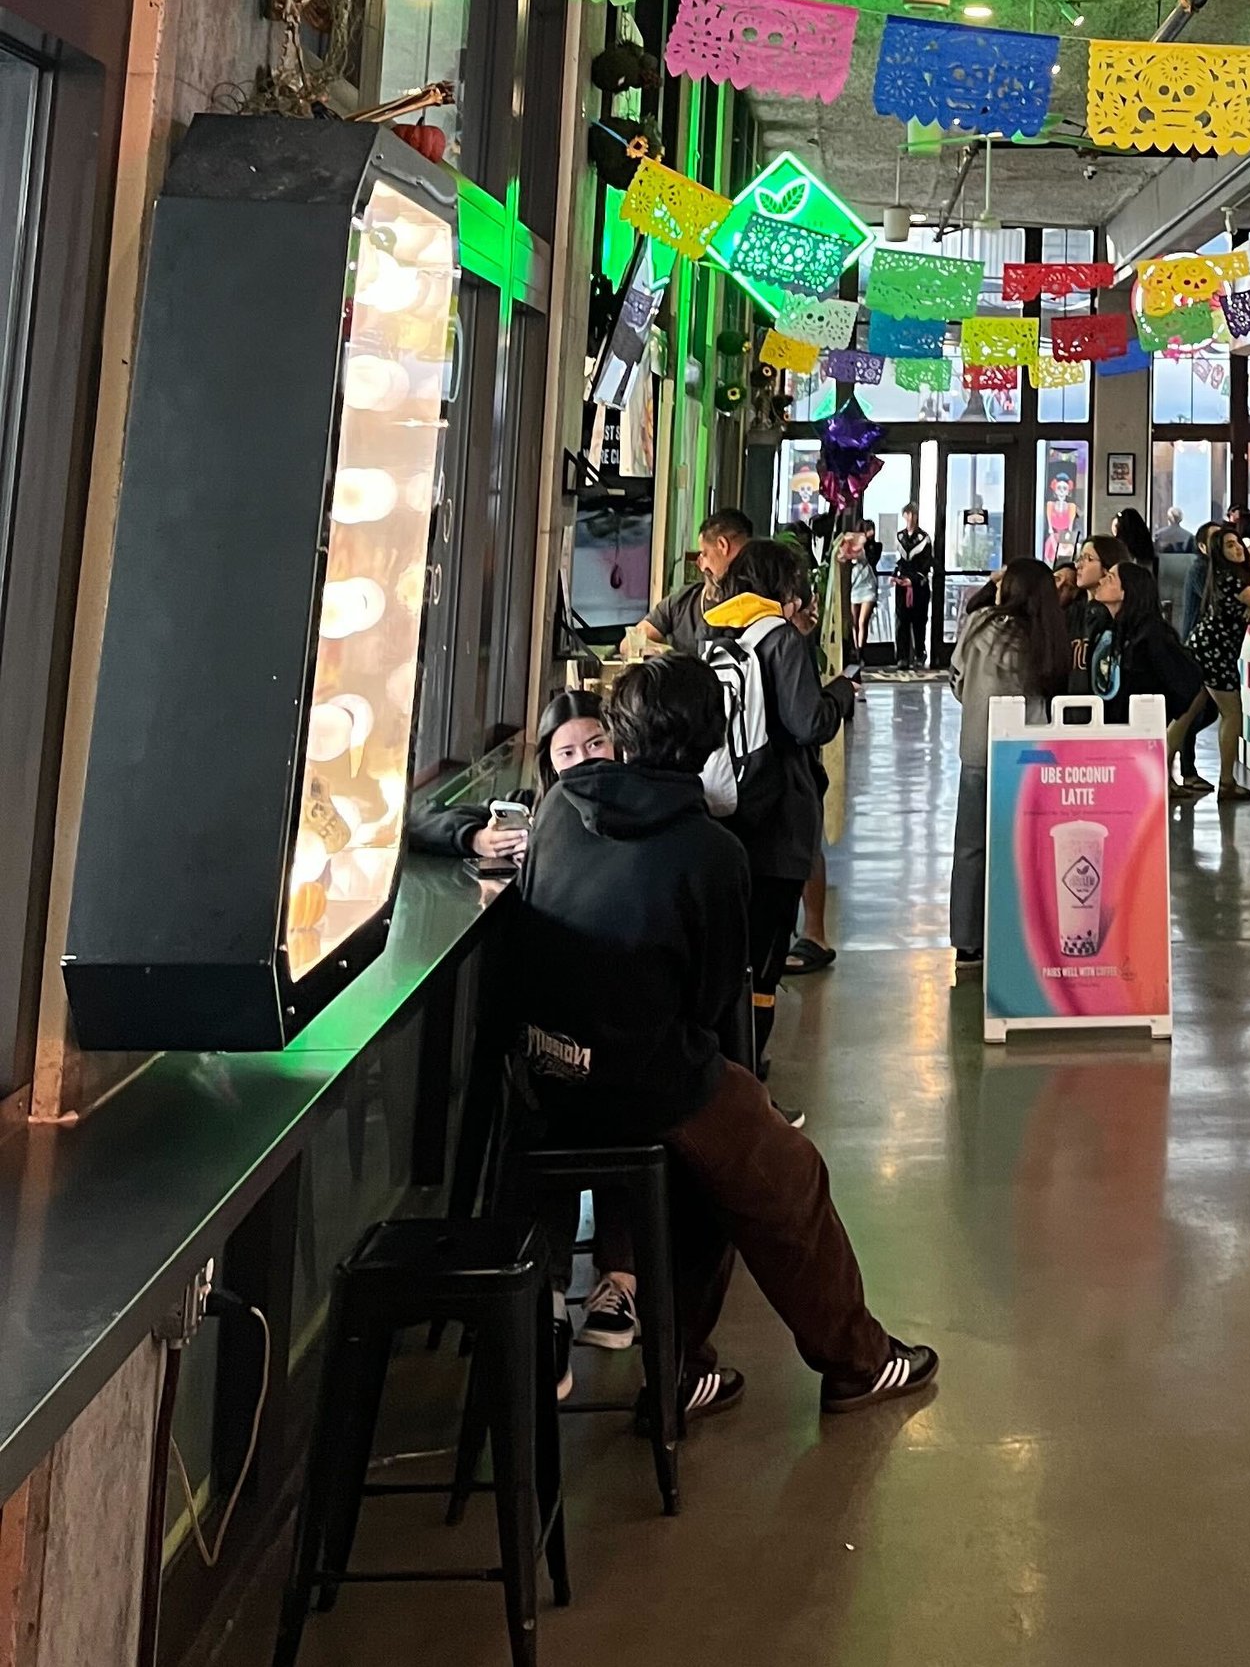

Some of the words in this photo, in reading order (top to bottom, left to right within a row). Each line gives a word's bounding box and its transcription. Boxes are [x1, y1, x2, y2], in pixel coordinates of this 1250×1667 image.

[1041, 766, 1062, 784] UBE
[1065, 765, 1116, 784] COCONUT
[1061, 787, 1095, 805] LATTE
[1042, 967, 1062, 978] PAIRS
[1062, 967, 1078, 977] WELL
[1079, 966, 1095, 977] WITH
